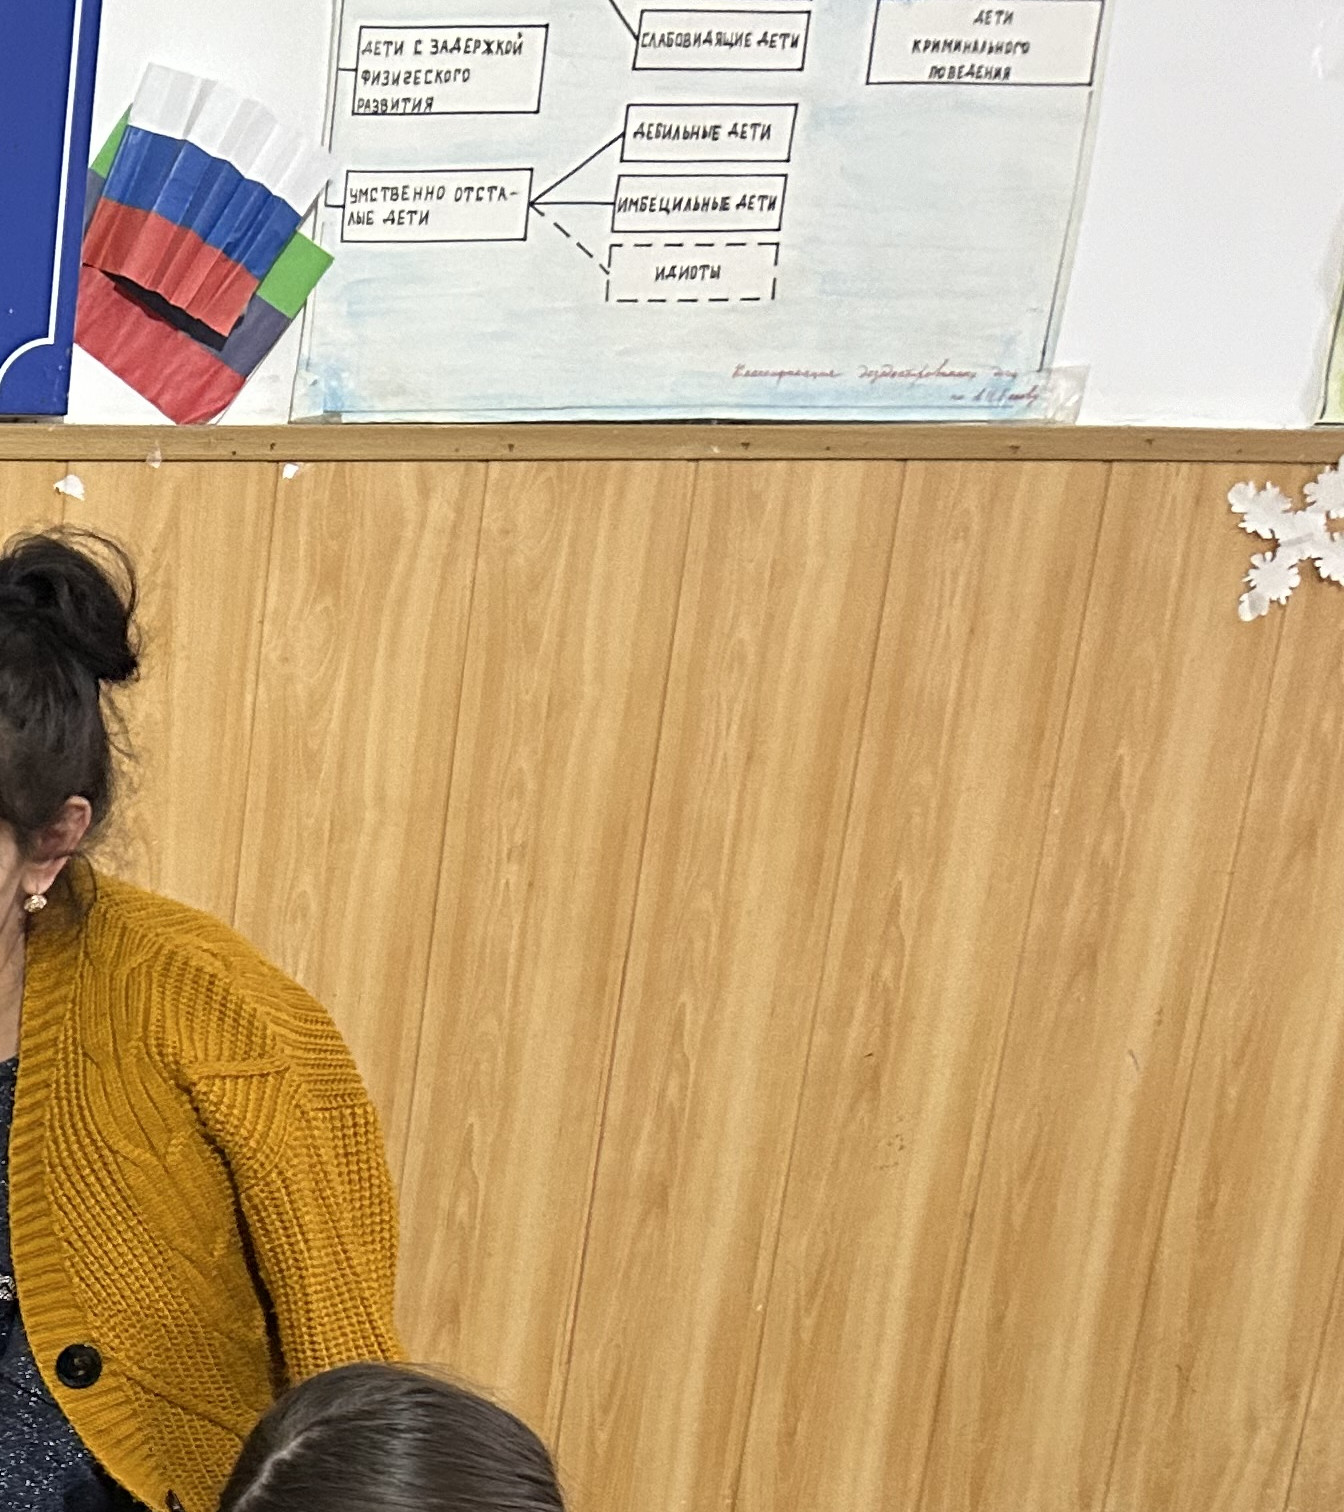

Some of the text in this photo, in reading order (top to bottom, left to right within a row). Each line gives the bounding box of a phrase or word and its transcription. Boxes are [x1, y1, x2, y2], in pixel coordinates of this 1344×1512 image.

[973, 9, 1014, 25] ДЕТИ
[362, 31, 524, 55] ДЕТИ С ЗАДЕРЖКОЙ
[641, 30, 800, 49] СЛАБОВИДЯЩИЕ ДЕТИ
[912, 39, 1031, 55] КРИМИНАЛЬНОГО
[928, 63, 1011, 81] ПОВЕДЕНИЯ
[357, 96, 434, 113] РАЗВИТИЯ
[633, 121, 772, 141] ДЕБИЛЬНЫЕ ДЕТИ
[349, 185, 518, 204] УМСТВЕННО ОТСТА-
[617, 194, 778, 215] ИМБЕЦИЛЬНЫЕ ДЕТИ
[348, 209, 430, 226] ЛЫЕ ДЕТИ
[655, 264, 722, 281] ИДИОТЫ
